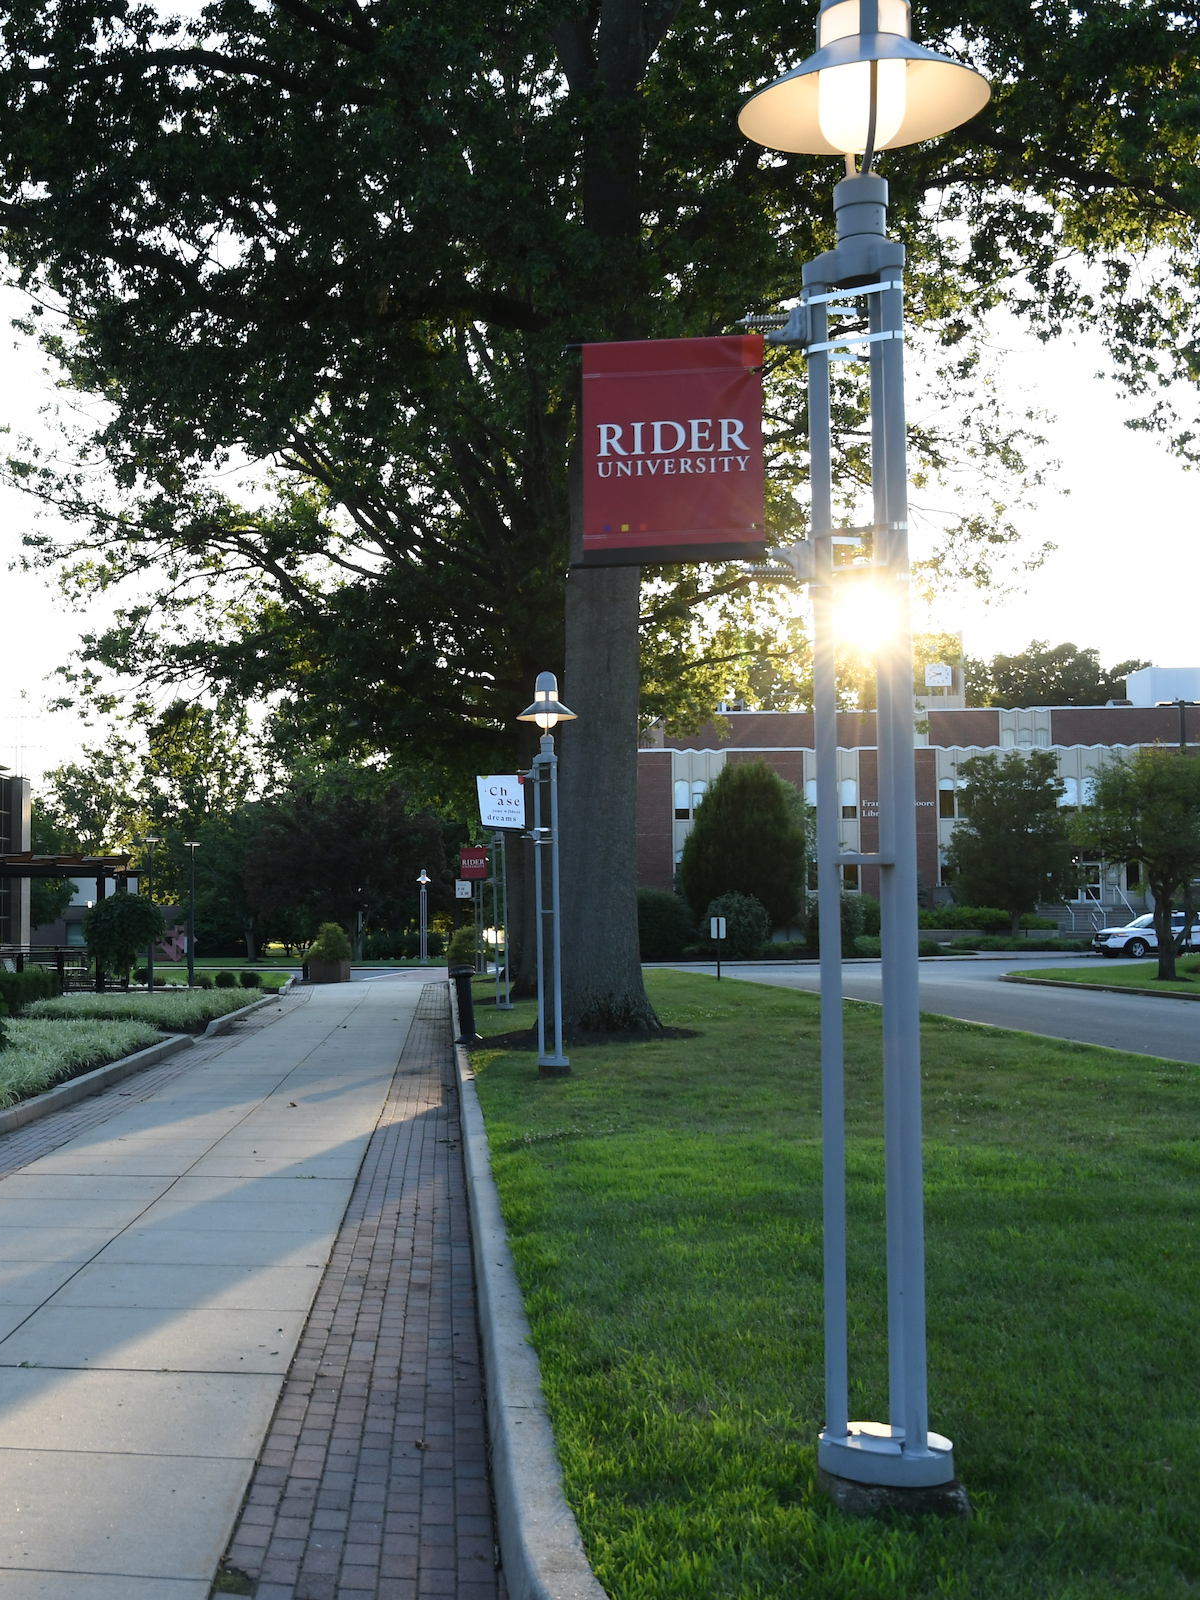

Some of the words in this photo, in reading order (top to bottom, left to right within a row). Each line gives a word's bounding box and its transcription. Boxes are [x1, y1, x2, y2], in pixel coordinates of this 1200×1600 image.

[596, 418, 751, 457] RIDER
[597, 455, 750, 478] UNIVERSITY
[489, 787, 508, 797] Ch
[497, 798, 520, 807] ase
[487, 814, 517, 822] dreams
